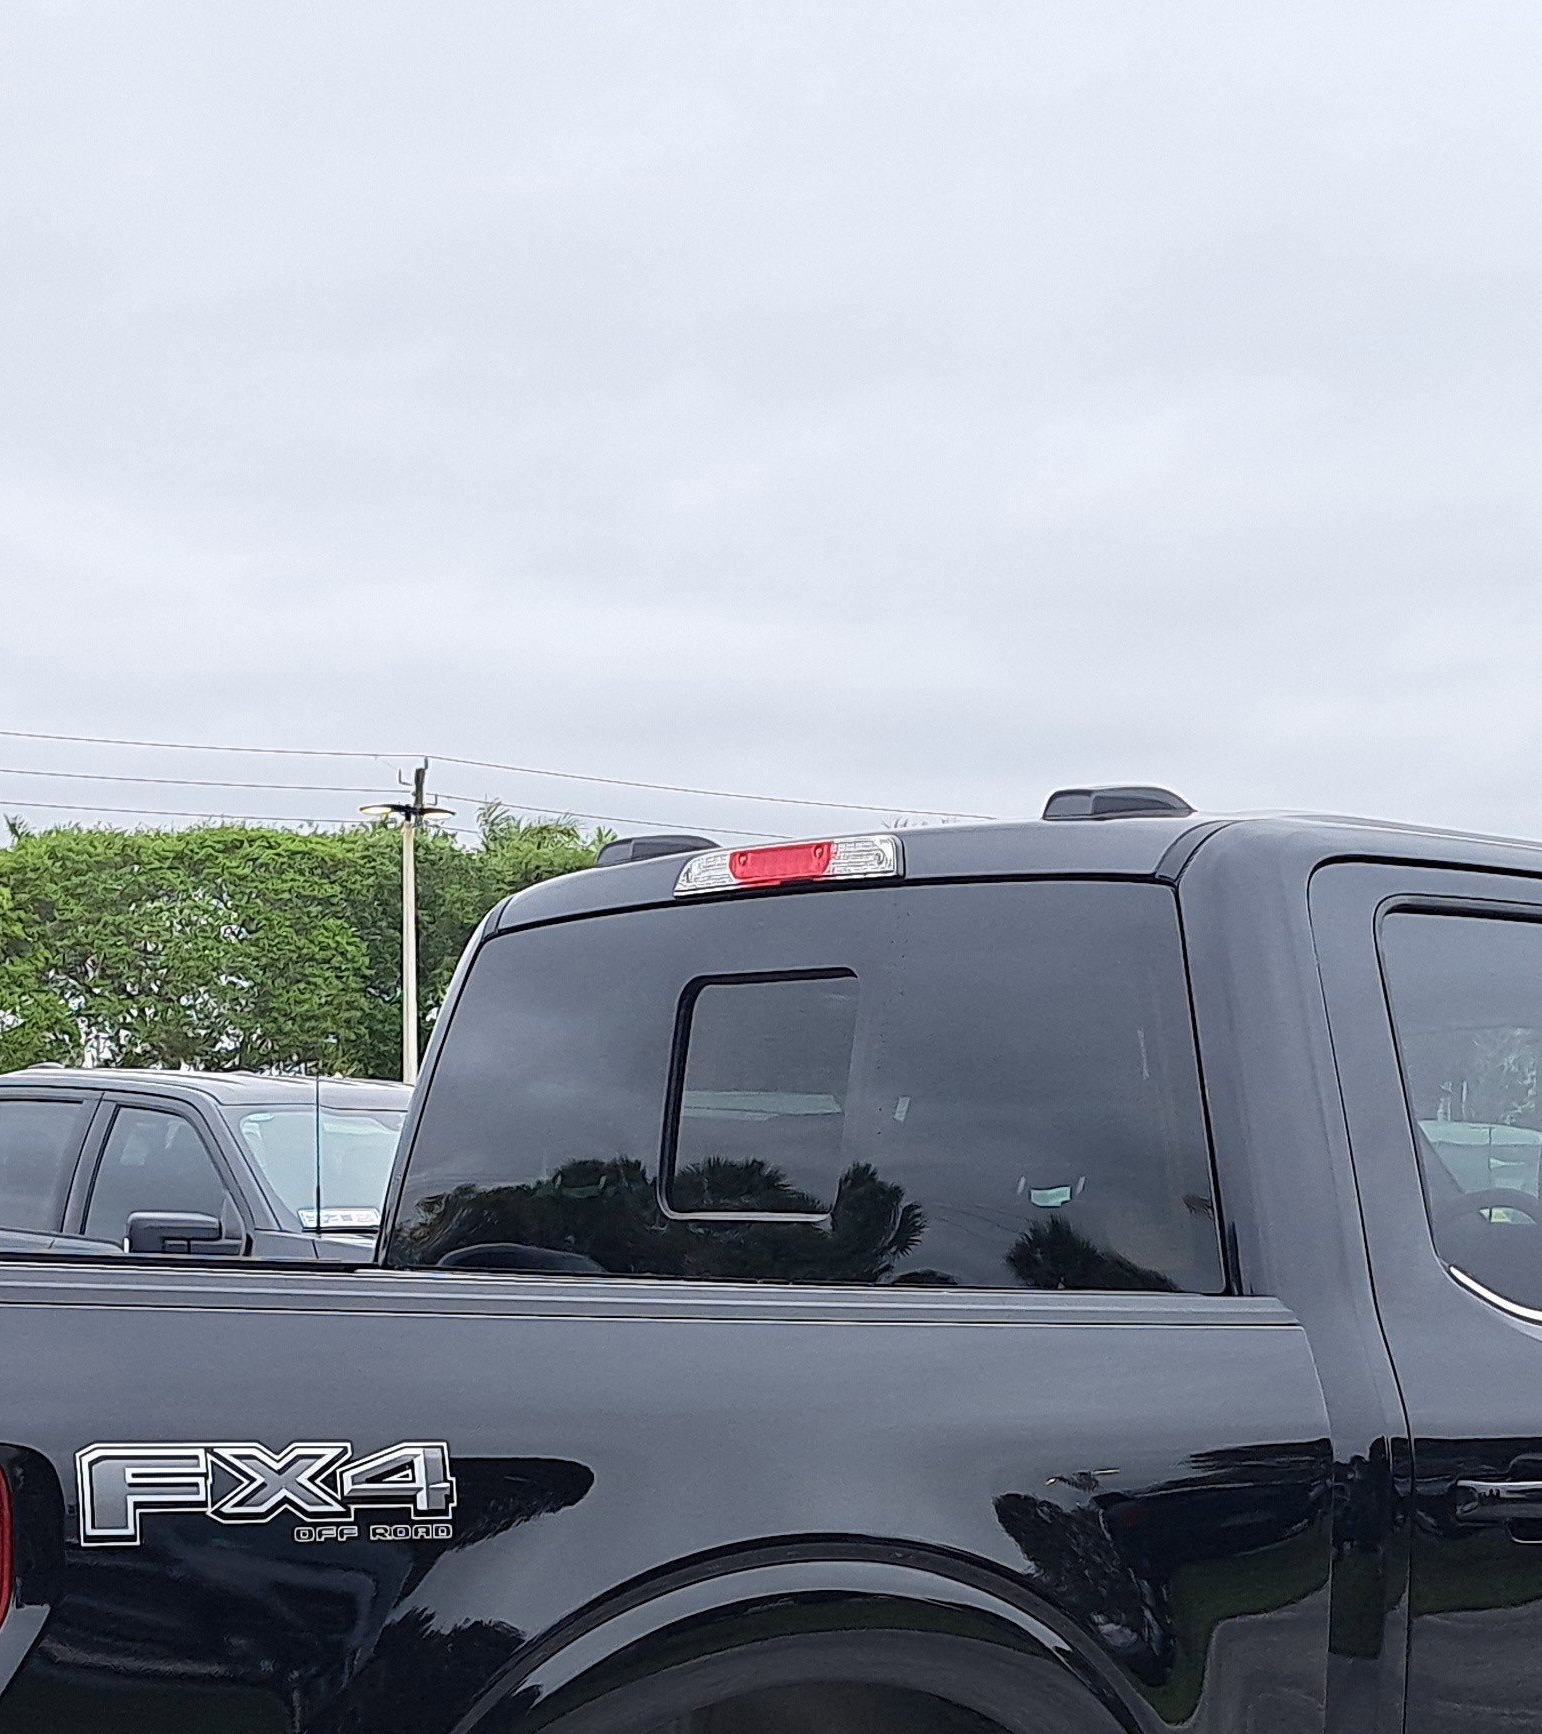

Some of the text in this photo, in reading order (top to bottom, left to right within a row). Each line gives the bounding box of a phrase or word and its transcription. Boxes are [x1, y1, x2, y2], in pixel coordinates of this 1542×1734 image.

[75, 1442, 457, 1547] FX4
[294, 1524, 453, 1543] OFF ROAD
